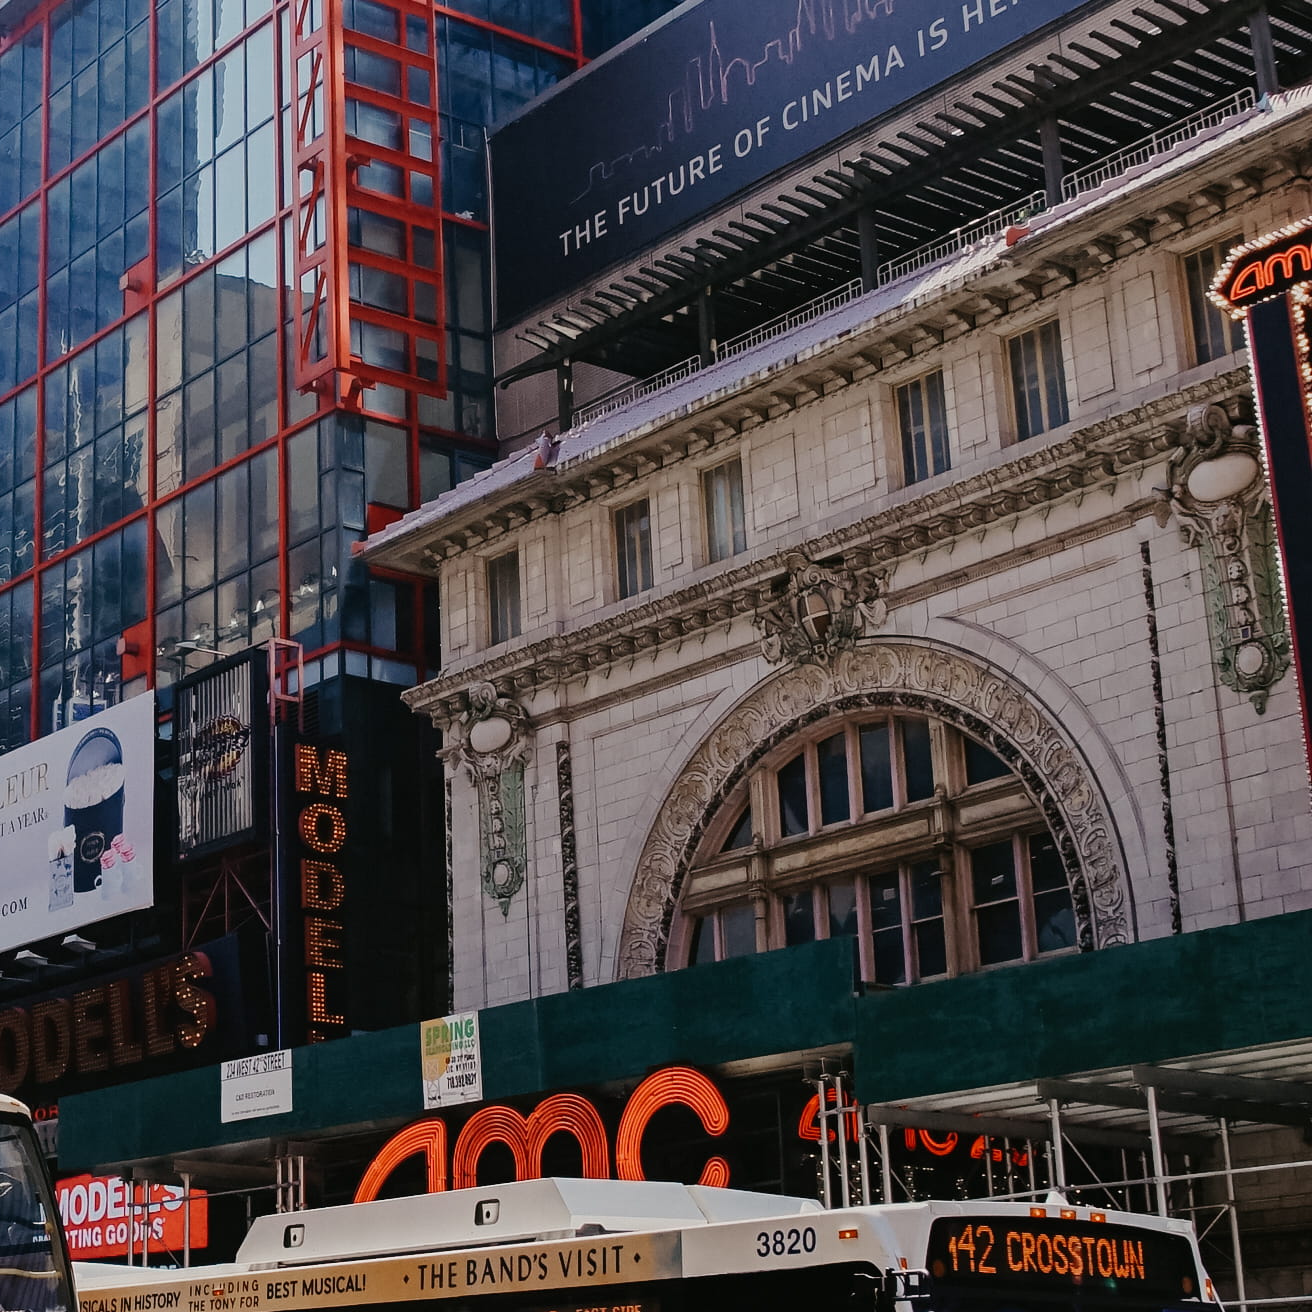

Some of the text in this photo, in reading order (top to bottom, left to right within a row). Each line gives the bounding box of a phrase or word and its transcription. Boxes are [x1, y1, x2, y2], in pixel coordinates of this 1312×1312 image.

[559, 210, 608, 258] THE
[618, 152, 724, 235] FUTURE
[734, 117, 772, 159] OF
[781, 45, 906, 131] CINEMA
[916, 19, 947, 53] IS
[1230, 244, 1312, 300] am
[7, 820, 15, 835] A
[295, 742, 349, 1044] MODEL
[425, 1018, 476, 1047] SPRING
[236, 1058, 253, 1078] WEST
[264, 1051, 286, 1073] STREET
[755, 1226, 818, 1259] 3820
[1005, 1229, 1147, 1281] CROSSTOWN
[417, 1244, 625, 1291] THE BAND'S VISIT
[119, 1294, 132, 1312] IN
[134, 1290, 182, 1311] HISTORY
[188, 1294, 261, 1312] THE TONY FOR
[265, 1274, 368, 1301] BEST MUSICAL!
